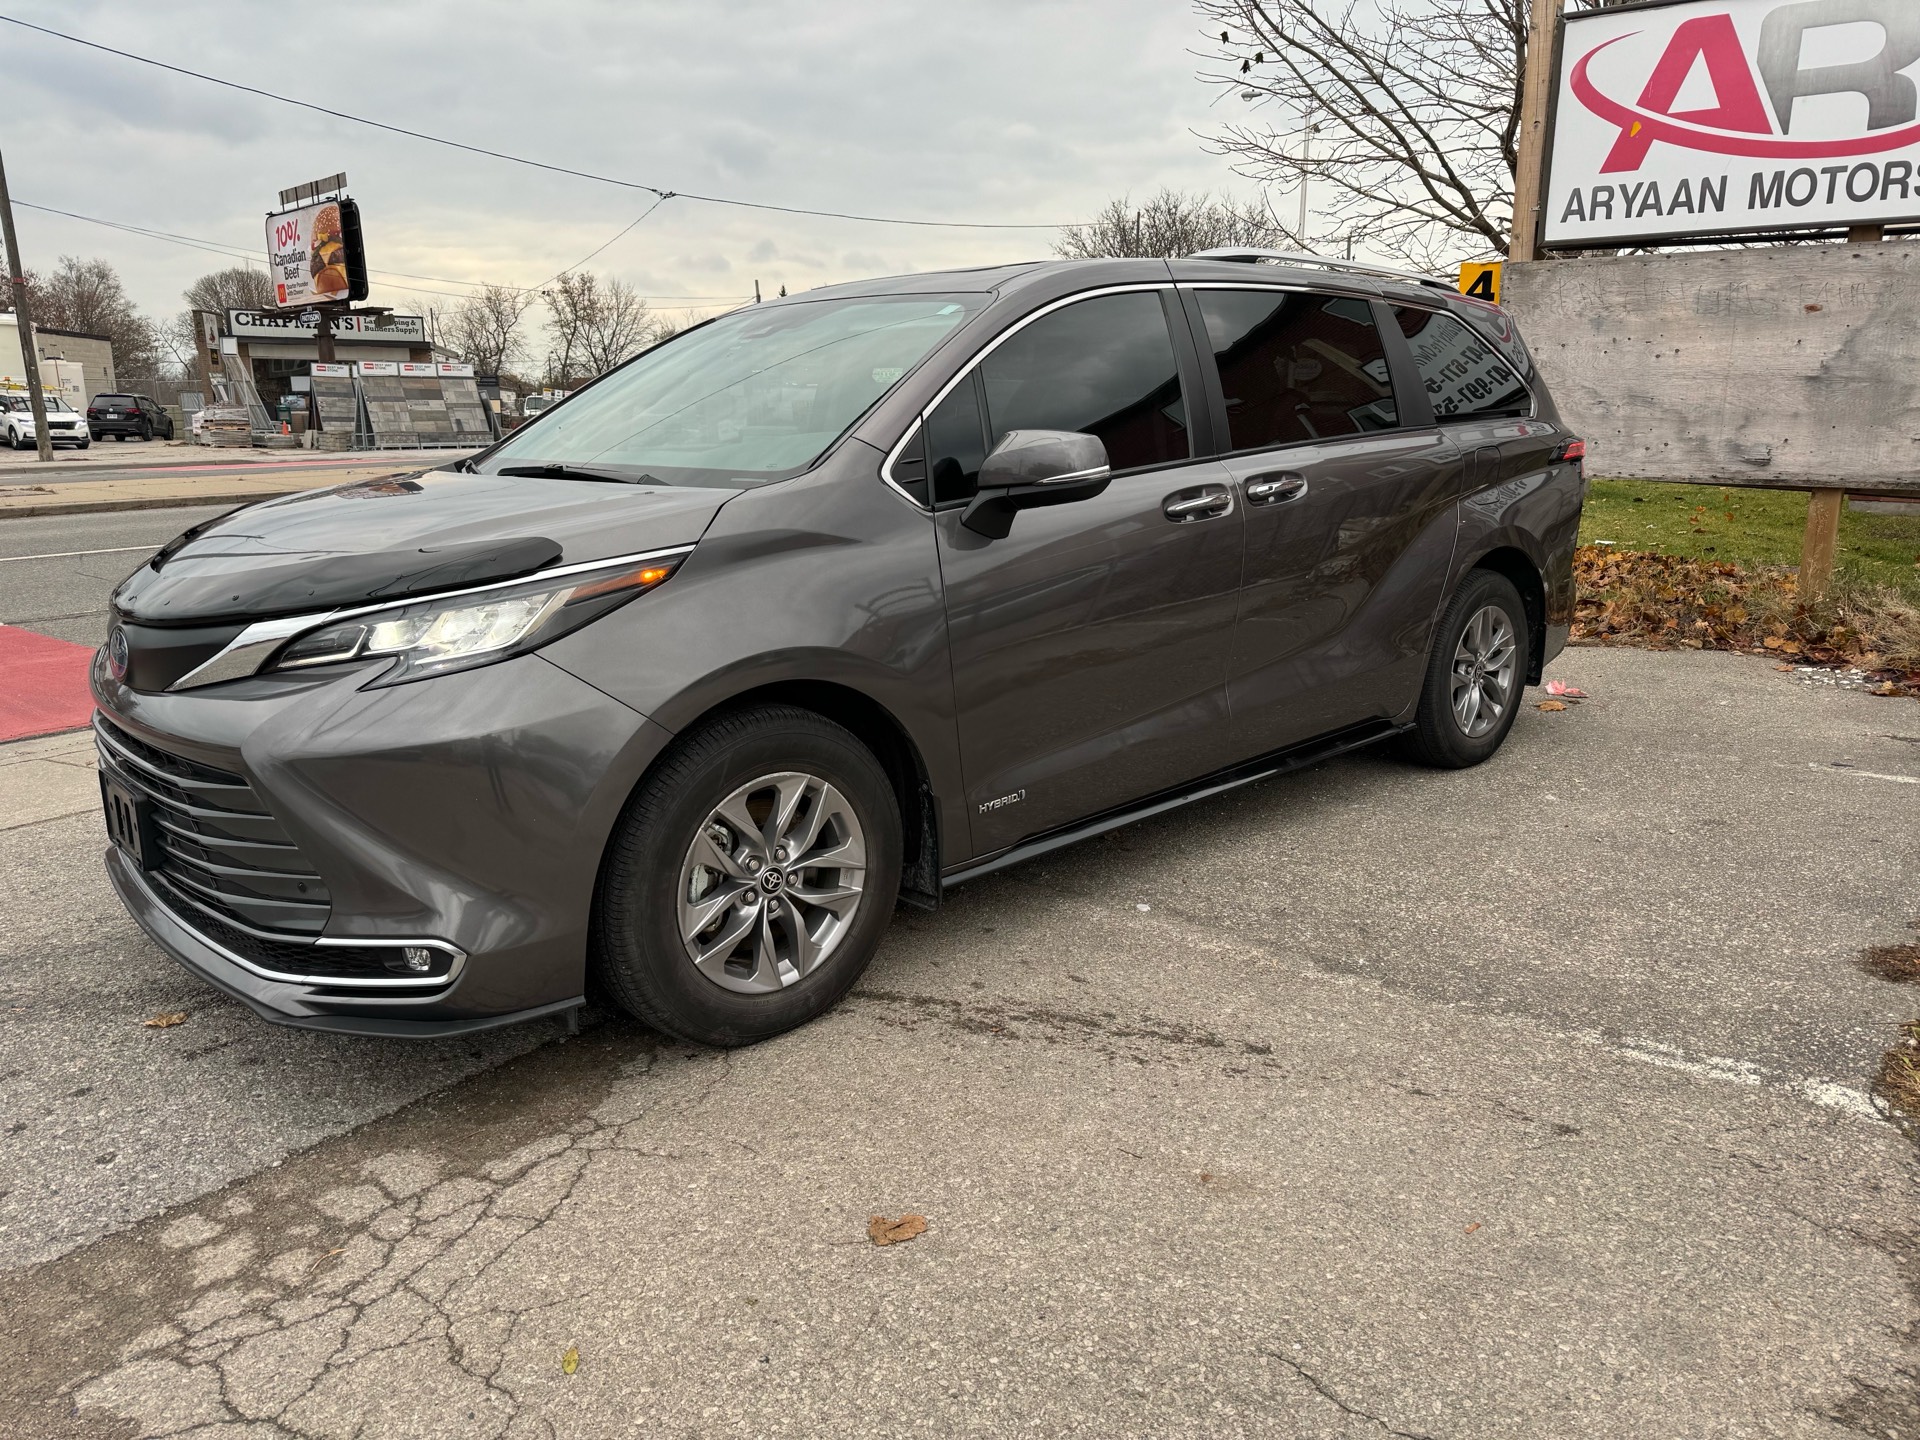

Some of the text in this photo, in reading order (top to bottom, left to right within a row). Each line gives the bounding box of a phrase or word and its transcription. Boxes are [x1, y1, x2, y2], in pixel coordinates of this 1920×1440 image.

[1560, 175, 1728, 223] ARYAAN
[276, 218, 300, 251] 100%
[274, 248, 306, 267] Canadian
[284, 264, 300, 280] Beef
[1465, 270, 1496, 302] 4
[978, 793, 1019, 814] HYBRID
